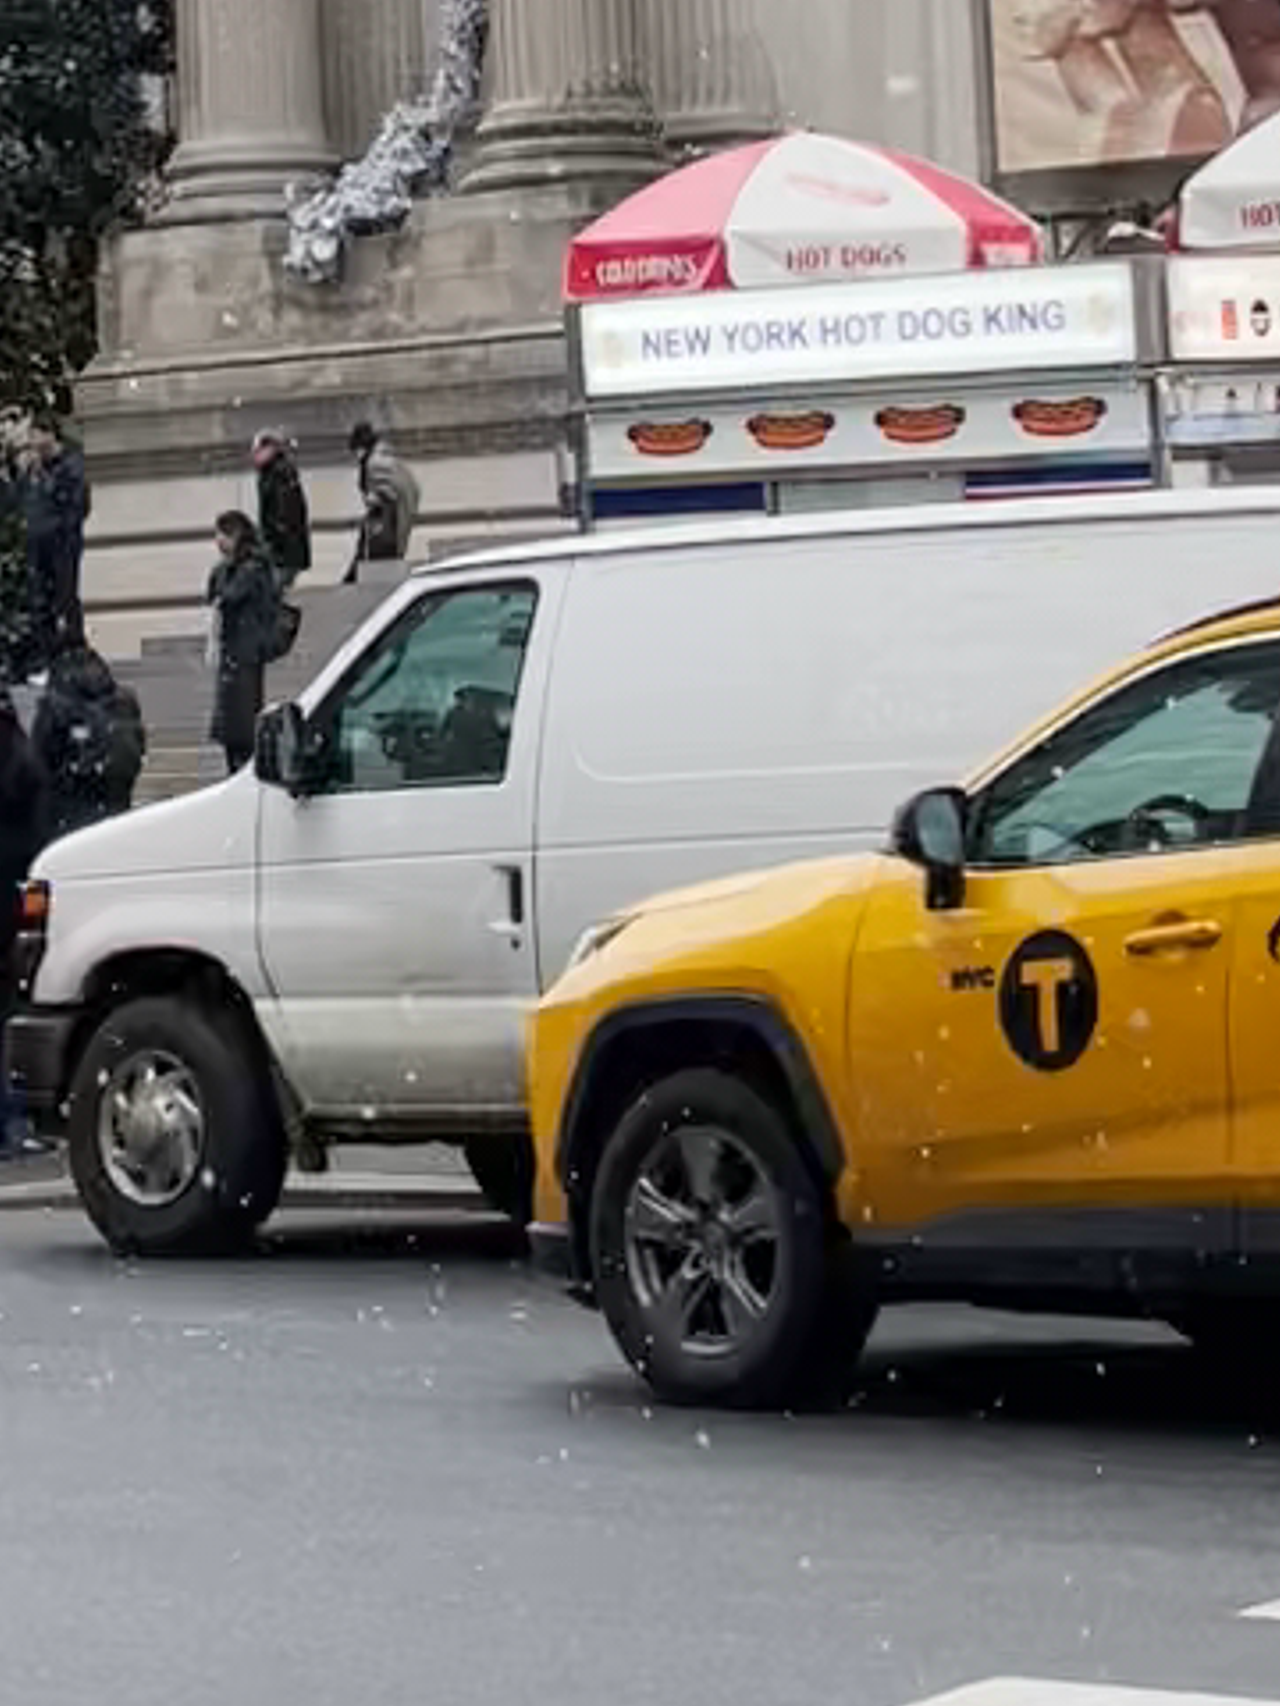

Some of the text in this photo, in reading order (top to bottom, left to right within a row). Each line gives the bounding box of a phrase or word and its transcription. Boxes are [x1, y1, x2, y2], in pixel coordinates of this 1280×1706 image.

[786, 244, 906, 270] HOT DOGS
[641, 300, 1066, 360] NEW YORK HOT DOG KING
